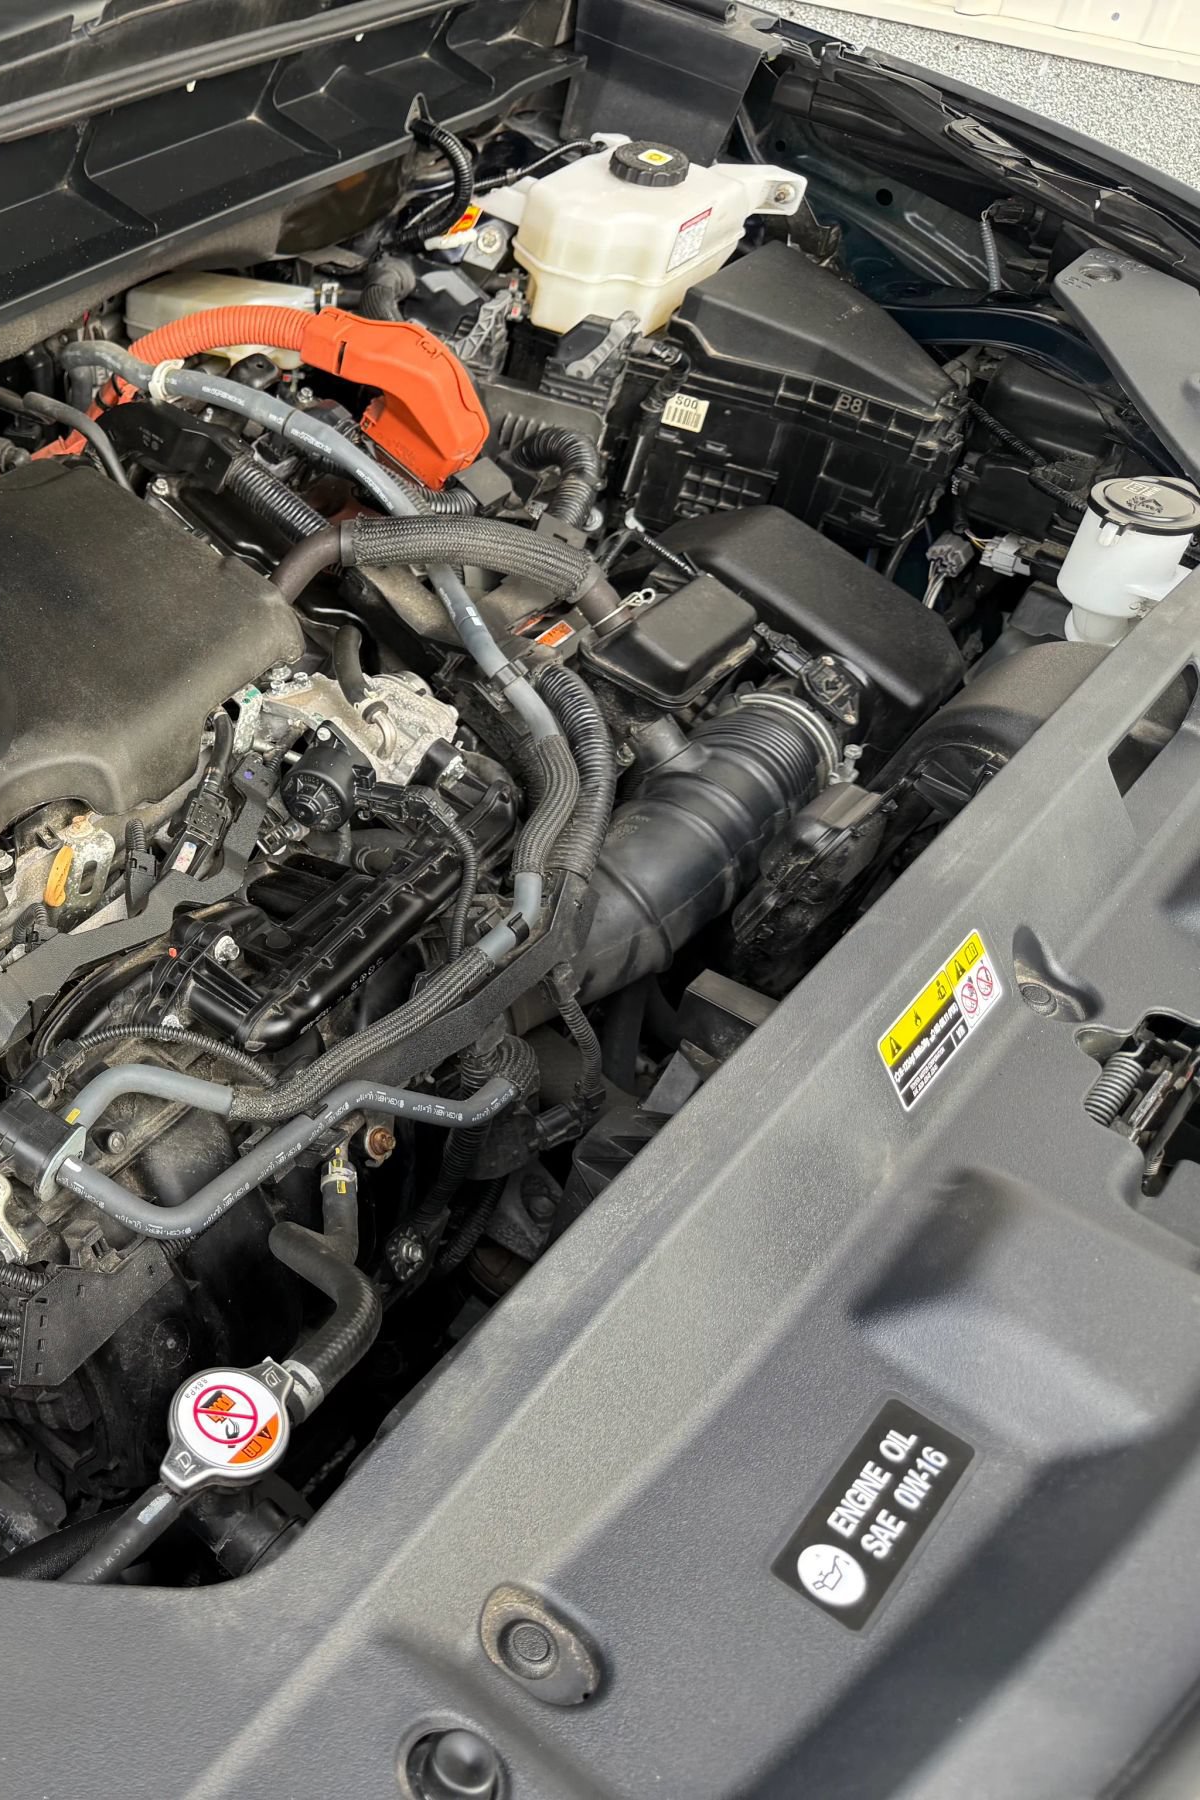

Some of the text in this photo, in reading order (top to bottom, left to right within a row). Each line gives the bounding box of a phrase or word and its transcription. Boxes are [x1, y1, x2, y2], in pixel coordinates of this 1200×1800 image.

[837, 393, 863, 414] B8
[826, 1428, 919, 1538] ENGINE OIL
[860, 1446, 949, 1560] SAE 0W-16
